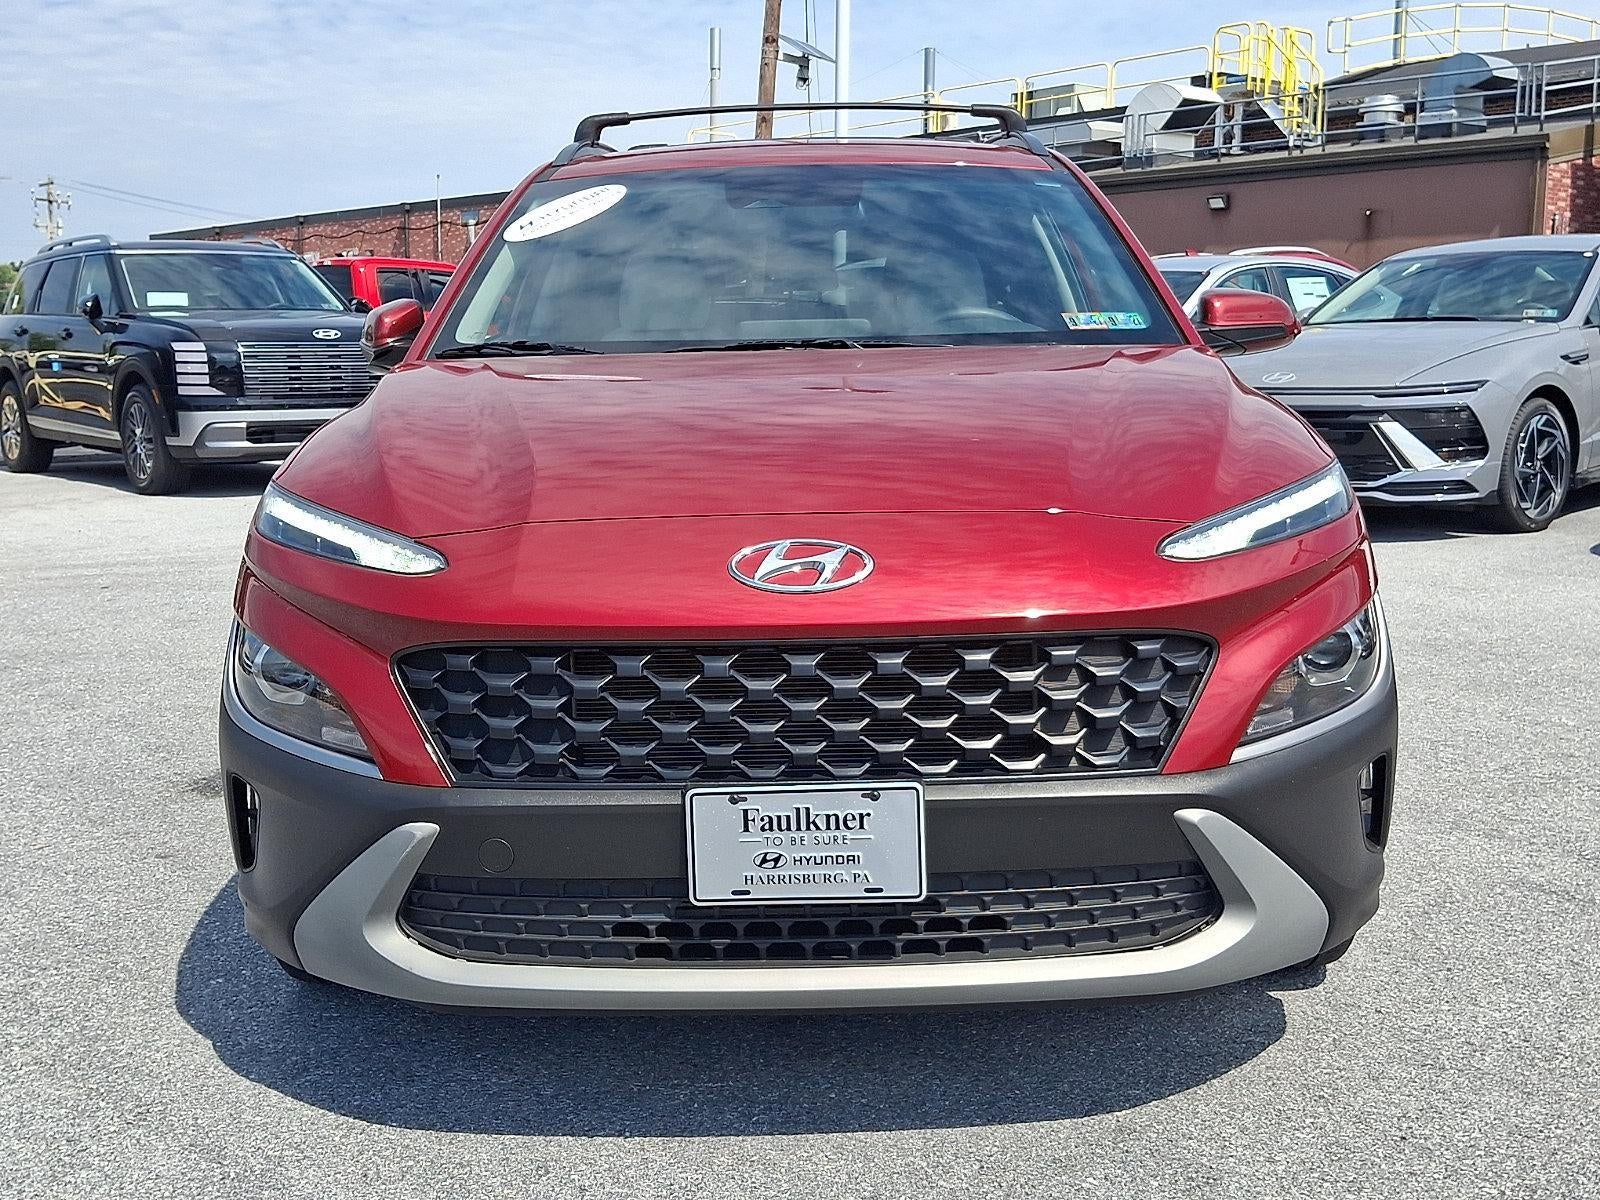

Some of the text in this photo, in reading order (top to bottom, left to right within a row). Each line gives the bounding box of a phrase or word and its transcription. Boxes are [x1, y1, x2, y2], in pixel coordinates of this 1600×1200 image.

[740, 806, 872, 833] Faulkner
[765, 834, 849, 847] TO BE SURE
[793, 854, 861, 866] HYUNDAI
[743, 872, 871, 886] HARRISBURG, PA
